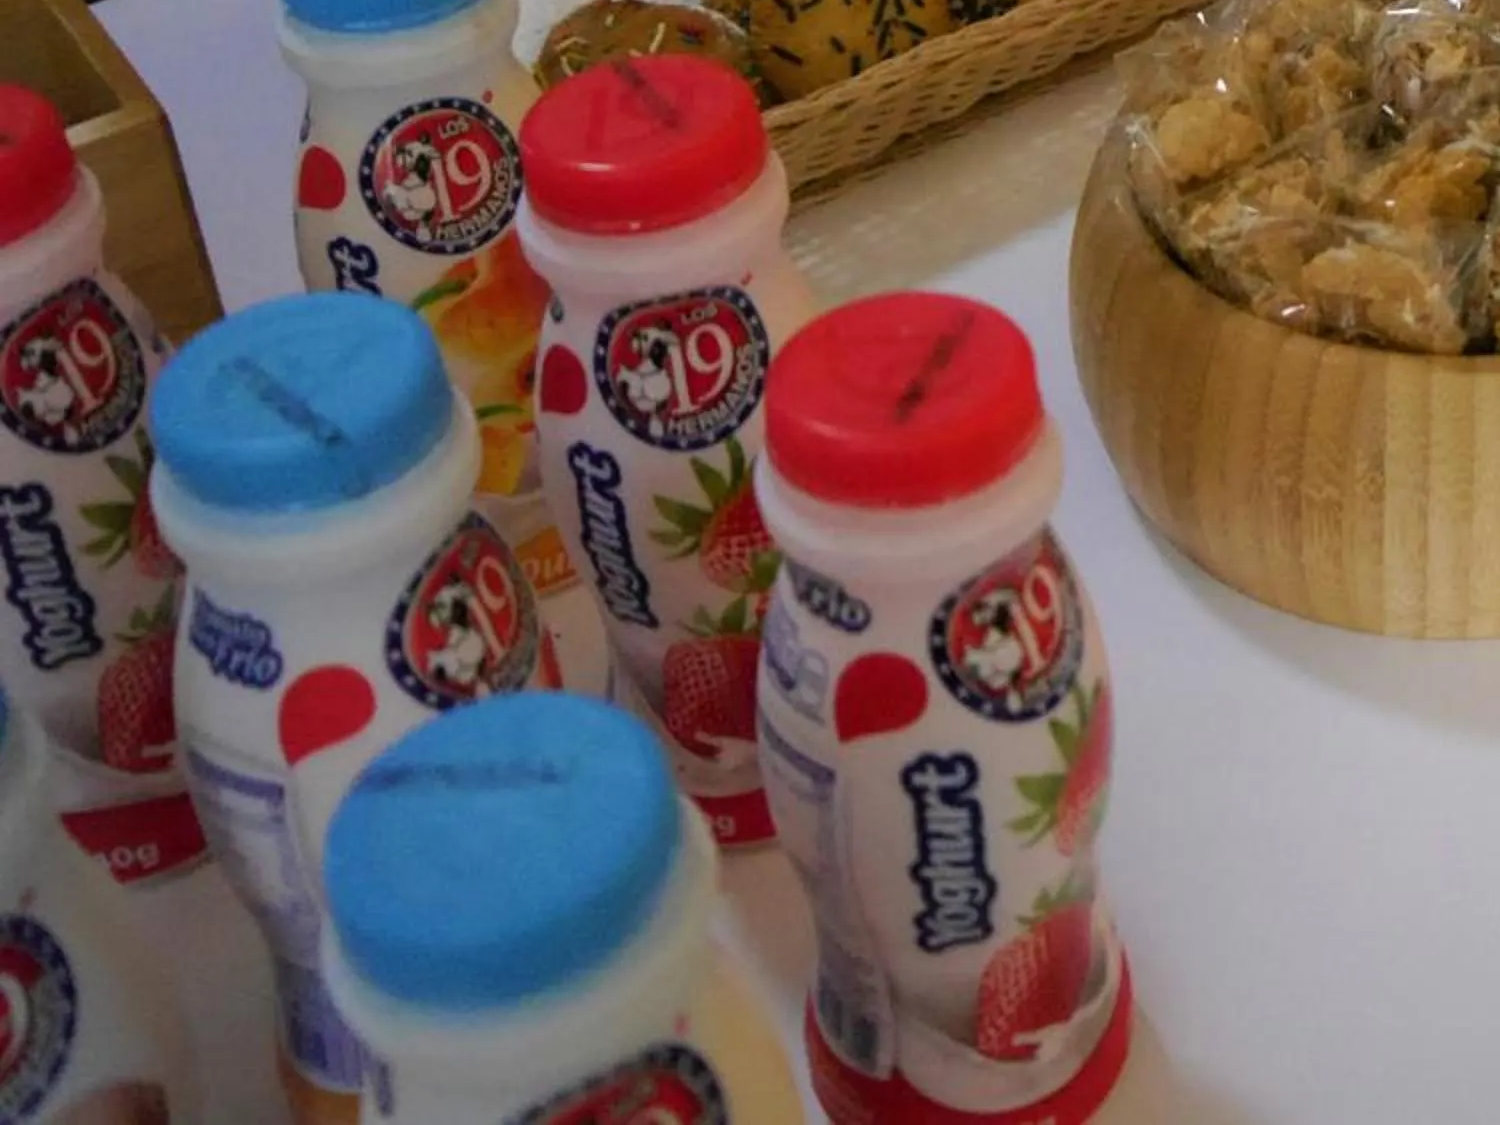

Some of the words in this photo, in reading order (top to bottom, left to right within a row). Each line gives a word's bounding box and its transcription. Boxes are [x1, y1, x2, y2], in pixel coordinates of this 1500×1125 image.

[430, 140, 493, 223] 19
[437, 115, 470, 139] LOS
[56, 319, 116, 415] 19
[669, 322, 735, 416] 19
[2, 484, 99, 668] Yoghurt
[569, 445, 656, 626] Yoghurt
[469, 555, 518, 665] 19
[1010, 565, 1063, 681] 19
[904, 755, 992, 952] Yoghurt
